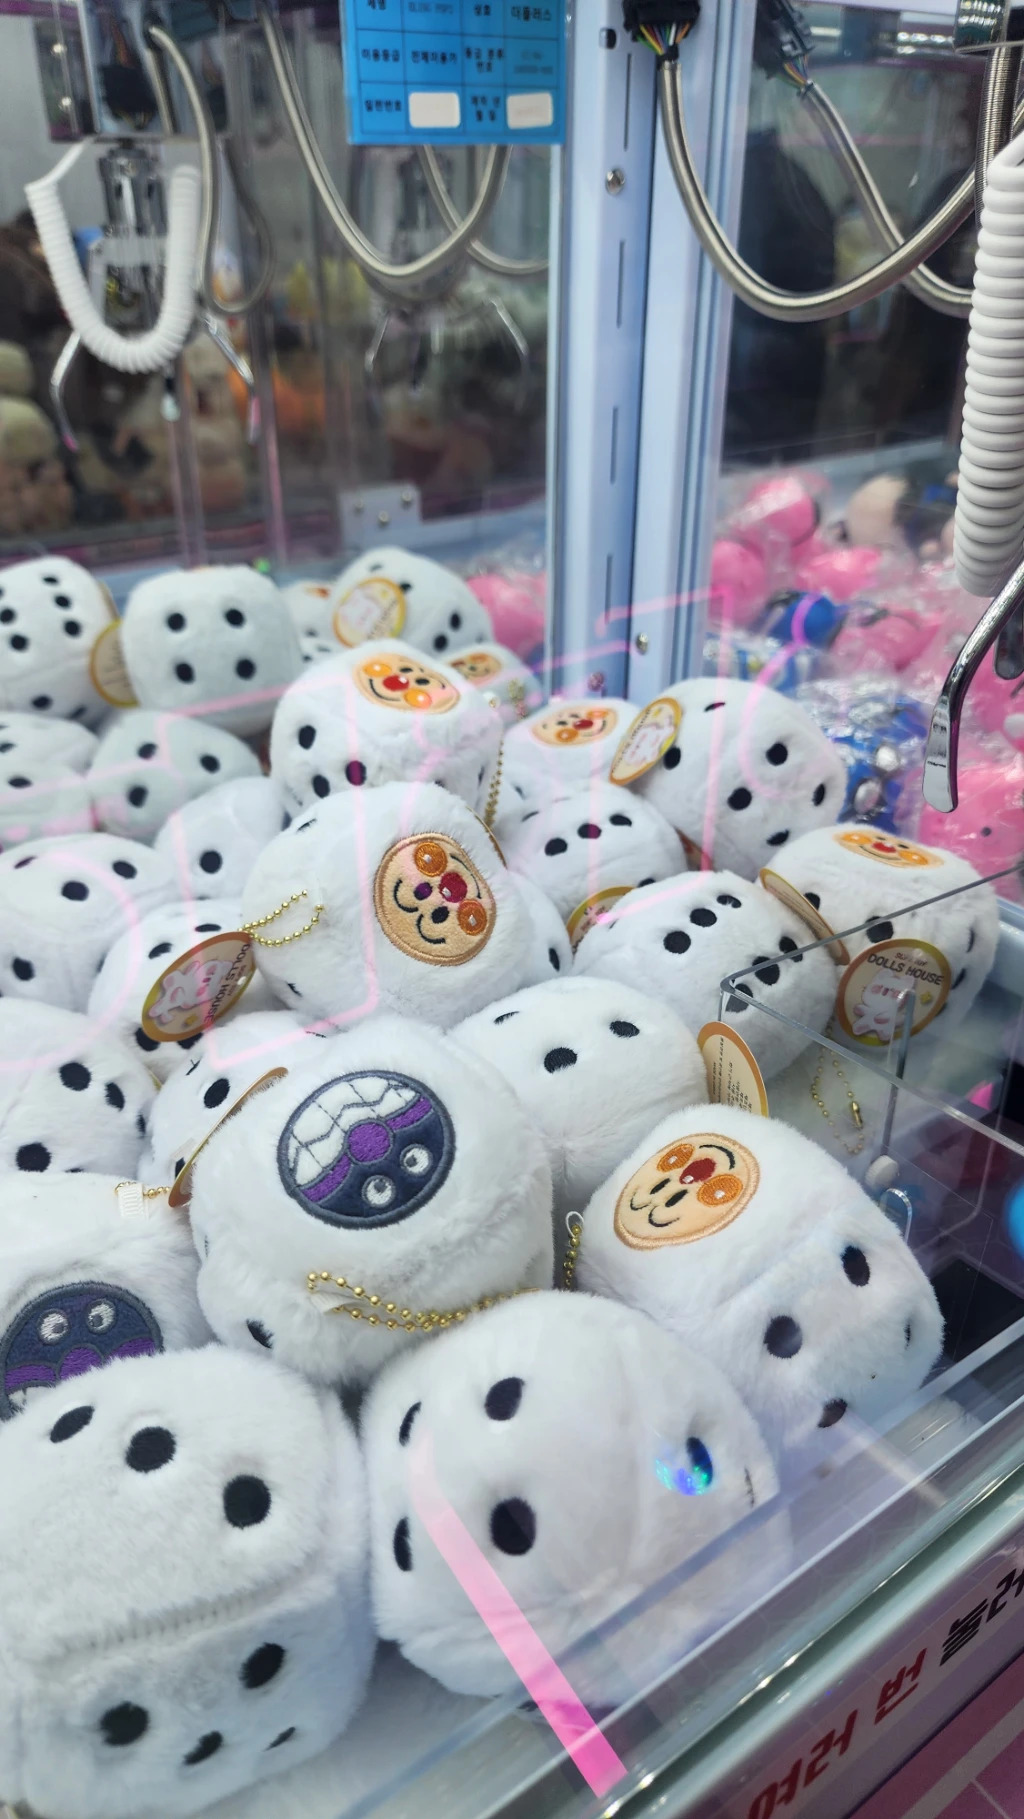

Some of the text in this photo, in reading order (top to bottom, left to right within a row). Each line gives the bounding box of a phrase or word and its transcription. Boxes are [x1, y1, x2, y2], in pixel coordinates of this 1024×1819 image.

[225, 943, 250, 981] DOLLS
[867, 953, 905, 973] DOLLS
[905, 966, 944, 985] HOUSE
[204, 984, 230, 1023] HOUSE
[748, 1708, 858, 1819] 여러
[874, 1648, 928, 1725] 번
